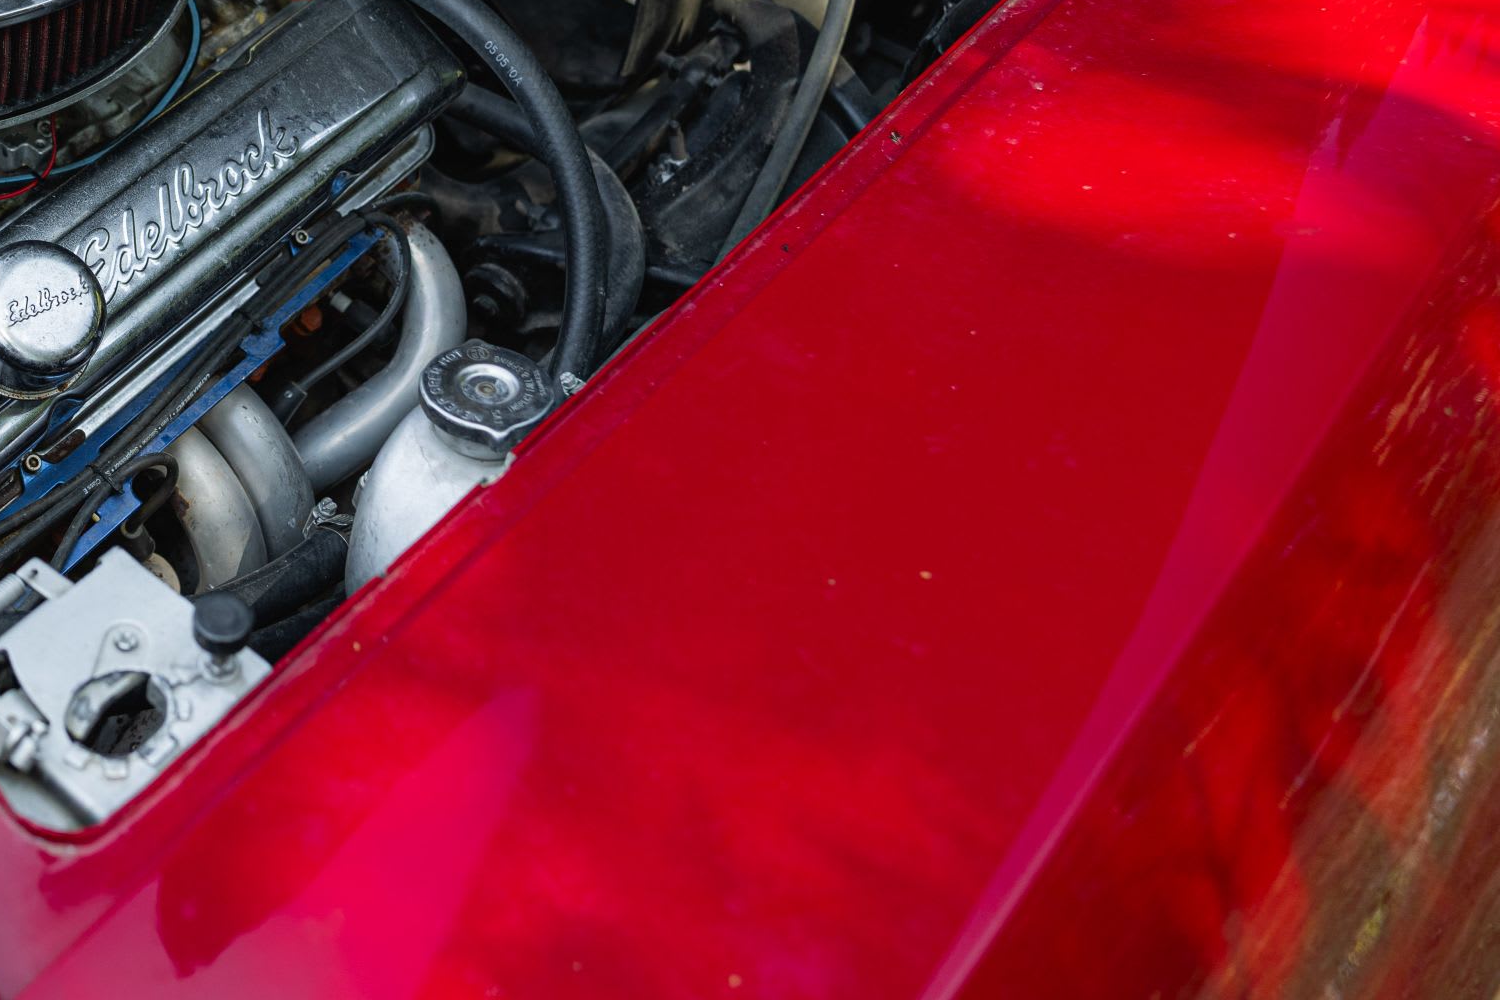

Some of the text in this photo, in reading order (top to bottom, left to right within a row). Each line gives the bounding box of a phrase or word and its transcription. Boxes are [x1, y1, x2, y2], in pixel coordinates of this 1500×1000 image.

[485, 41, 498, 54] 05
[496, 53, 510, 68] 05
[76, 106, 299, 304] Edelbrock
[8, 273, 90, 327] Edelbrock
[438, 350, 463, 366] HOT
